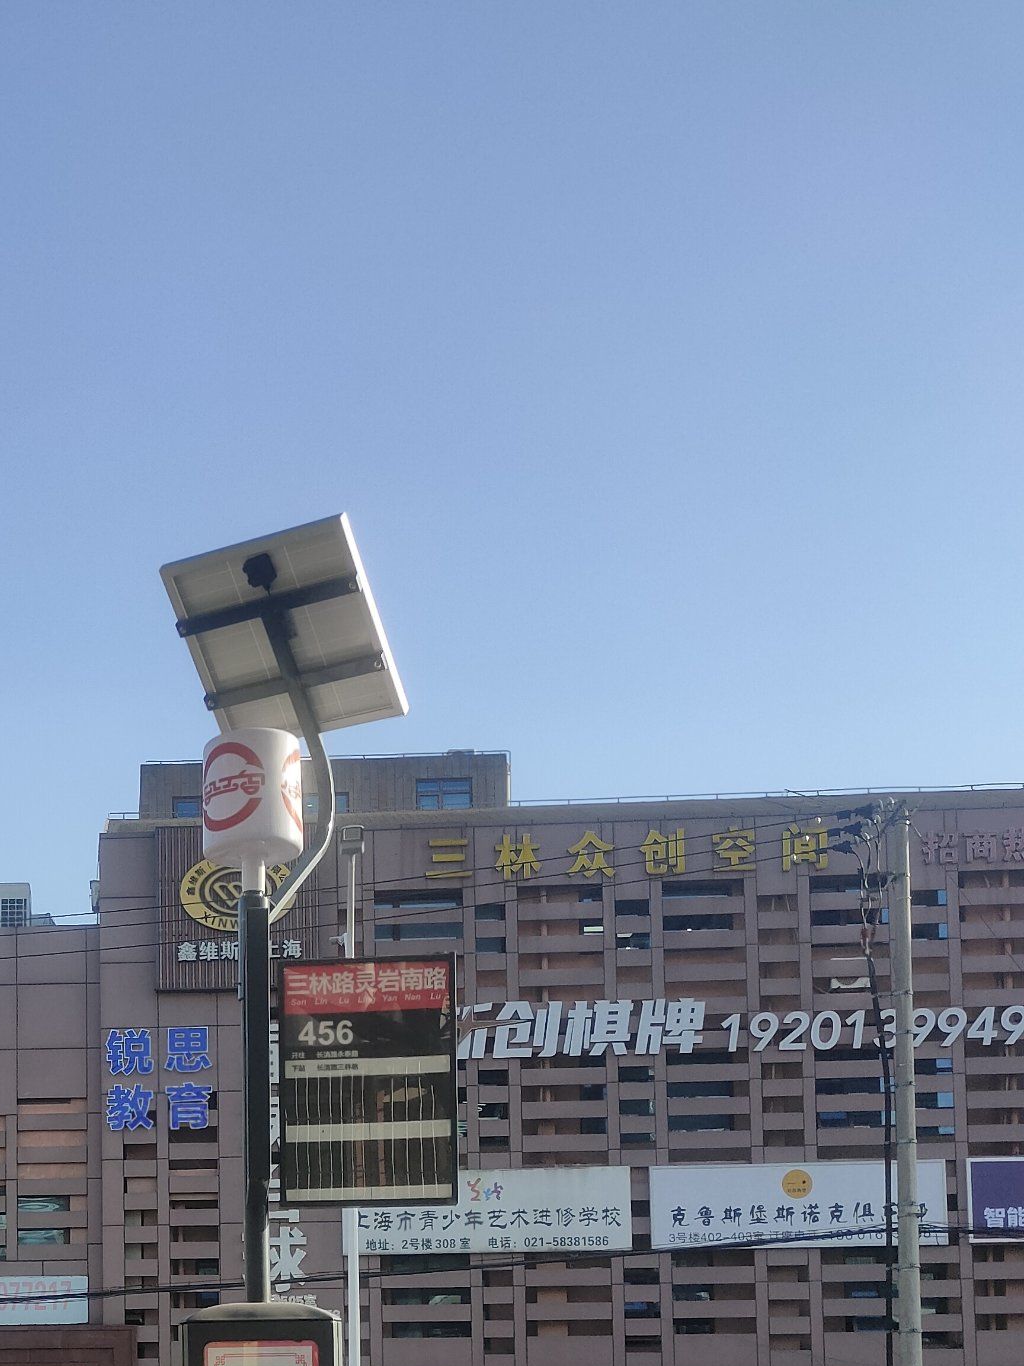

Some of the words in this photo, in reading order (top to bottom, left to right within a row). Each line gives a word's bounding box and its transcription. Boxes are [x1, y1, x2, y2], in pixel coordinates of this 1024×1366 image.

[425, 824, 828, 881] 三林众创空间
[287, 966, 447, 996] 三林路灵岩南路
[315, 997, 328, 1005] Lin
[339, 997, 350, 1005] Lu
[382, 994, 398, 1002] Yan
[404, 993, 421, 1001] Nan
[430, 991, 442, 1000] Lu
[298, 1020, 353, 1046] 456
[105, 1026, 212, 1075] 锐思
[105, 1082, 213, 1131] 教育
[358, 1206, 623, 1233] 上海市青少年艺术进修学校
